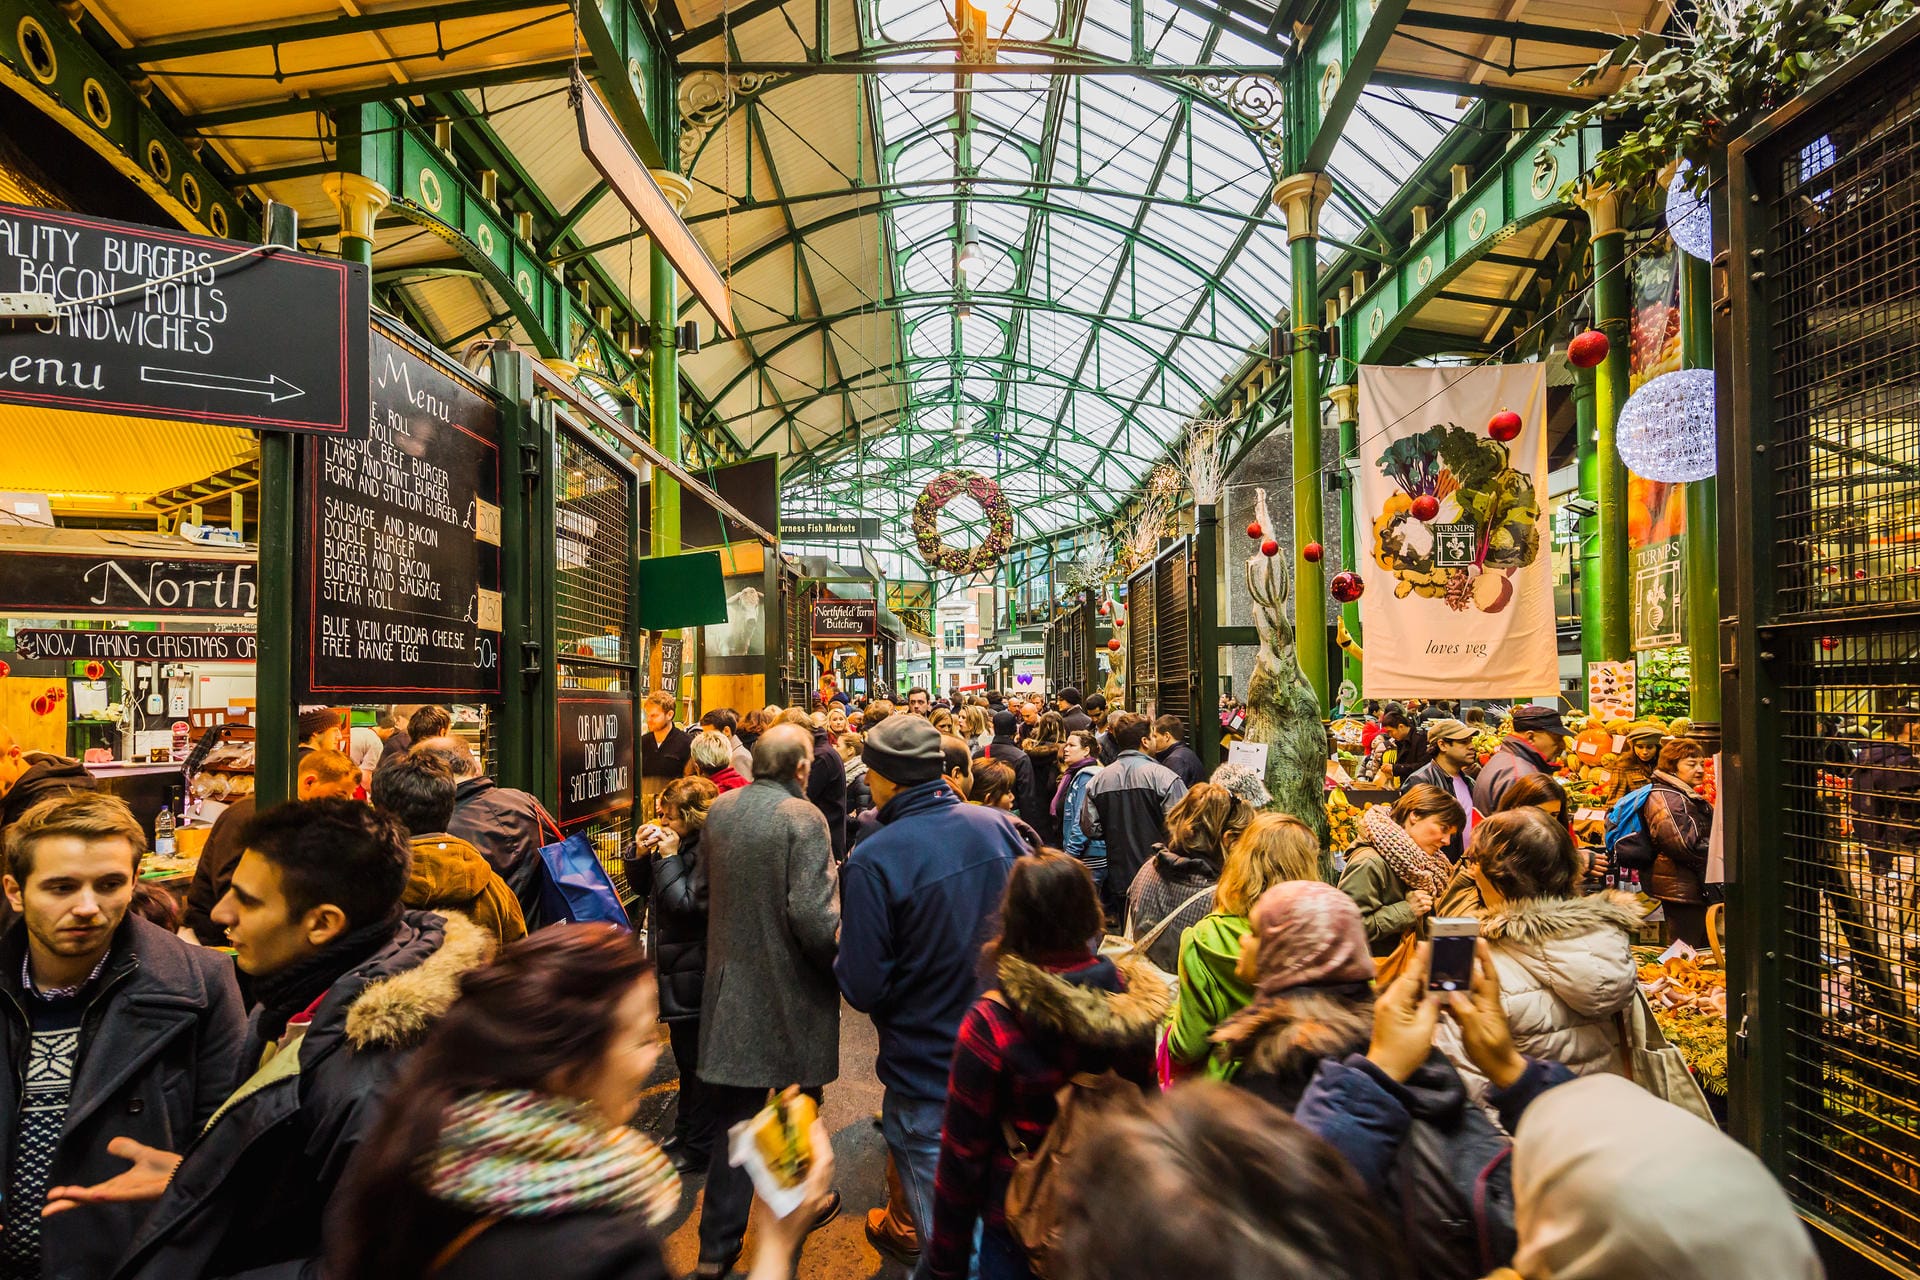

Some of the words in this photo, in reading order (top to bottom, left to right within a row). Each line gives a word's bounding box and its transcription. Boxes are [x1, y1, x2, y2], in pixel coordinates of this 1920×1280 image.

[104, 237, 215, 286] BURGERS
[20, 258, 115, 306] BACON
[145, 278, 228, 323] ROLLS
[0, 355, 105, 390] enu
[377, 353, 450, 423] Menu
[370, 420, 395, 447] ROLL
[388, 409, 411, 437] ROLL
[325, 440, 357, 471] LAMB
[361, 456, 383, 481] AND
[386, 465, 410, 490] MINT
[415, 477, 450, 505] BURGER
[381, 443, 405, 469] BEEF
[412, 457, 449, 489] BURGER
[325, 461, 355, 490] PORK
[359, 474, 379, 498] AND
[383, 483, 422, 513] STILTON
[426, 499, 459, 526] BURGER
[324, 496, 377, 530] SAUSAGE
[384, 515, 404, 537] AND
[408, 522, 438, 548] BACON
[324, 518, 367, 547] DOUBLE
[374, 532, 416, 559] BURGER
[807, 523, 823, 533] Fish
[825, 523, 856, 533] Markets
[1436, 524, 1475, 532] TURNIPS
[324, 538, 367, 566] BURGER
[372, 551, 393, 572] AND
[399, 557, 430, 580] BACON
[323, 580, 361, 606] STEAK
[368, 588, 394, 611] ROLL
[324, 559, 369, 588] BURGER
[373, 572, 394, 592] AND
[399, 576, 441, 601] SAUSAGE
[815, 605, 854, 620] Northfield
[854, 605, 875, 617] Farm
[822, 617, 863, 632] Butchery
[35, 633, 76, 656] NOW
[85, 634, 139, 657] TAKING
[146, 635, 228, 658] CHRISTMAS
[322, 615, 351, 638] BLUE
[356, 620, 380, 641] VEIN
[385, 623, 428, 647] CHEDDAR
[432, 629, 465, 650] CHEESE
[322, 636, 351, 658] FREE
[358, 640, 394, 661] RANGE
[401, 645, 419, 662] EGG
[1425, 639, 1460, 654] loves
[1465, 642, 1488, 658] veg
[577, 714, 591, 742] OUR
[591, 714, 605, 741] OWN
[570, 772, 587, 803] SALT
[588, 769, 602, 799] BEEF
[604, 766, 628, 795] SANDWICH
